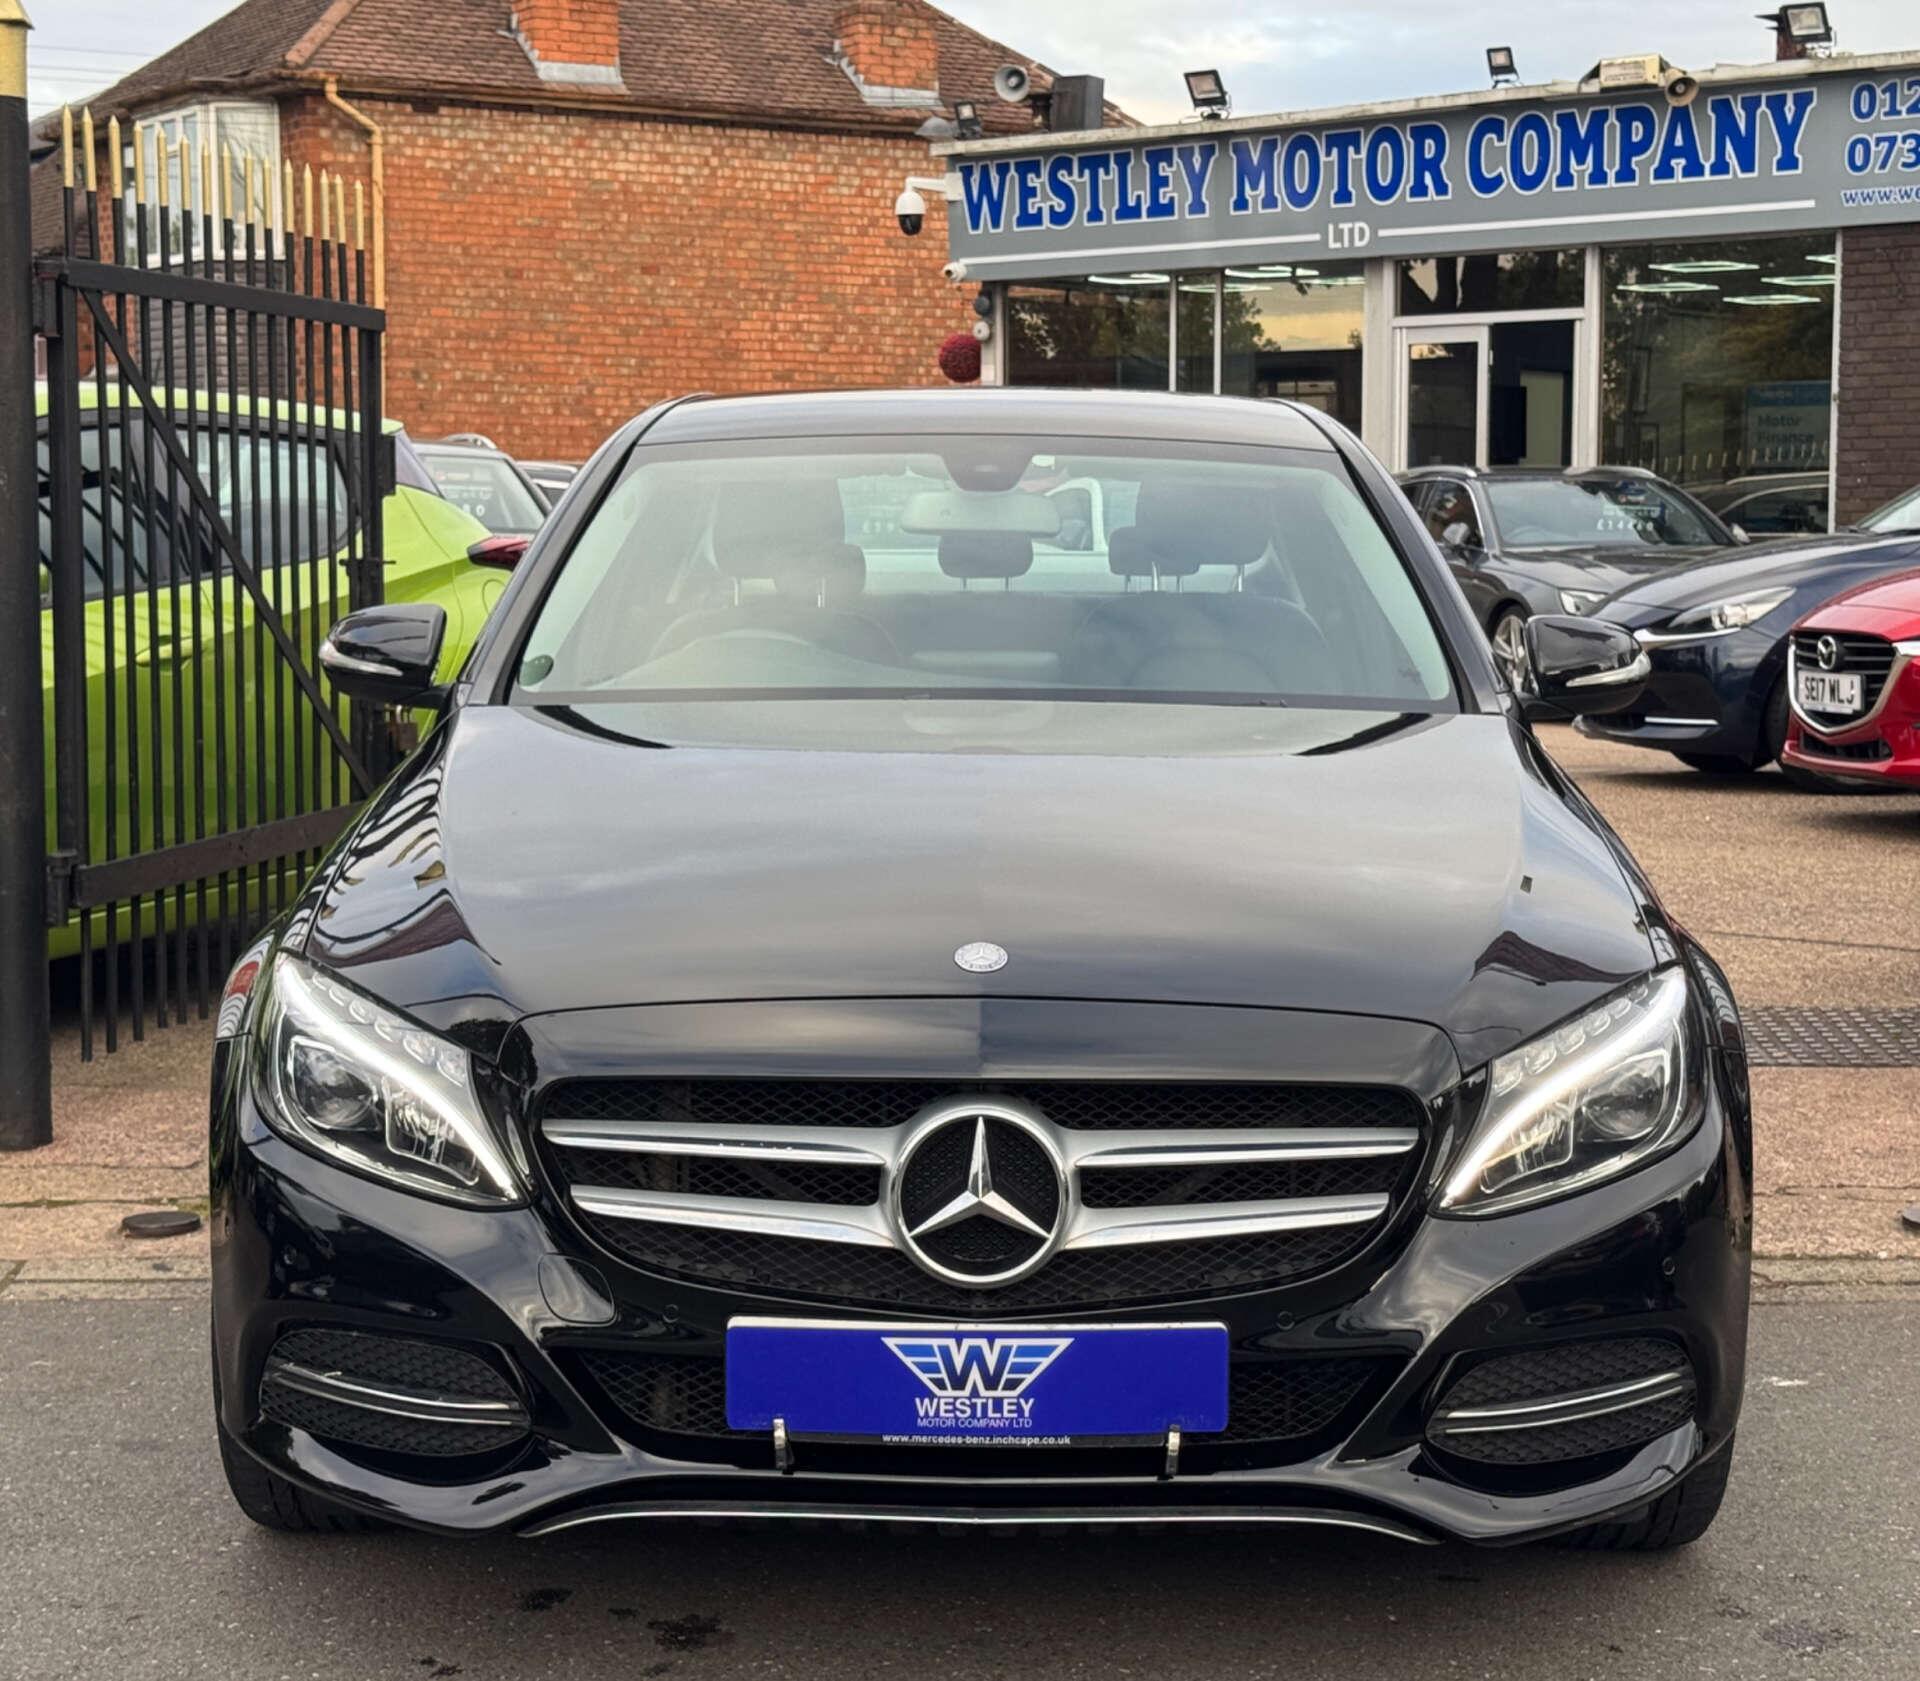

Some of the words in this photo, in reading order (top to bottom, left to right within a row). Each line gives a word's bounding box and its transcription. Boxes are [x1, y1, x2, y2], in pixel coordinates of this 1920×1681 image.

[1850, 76, 1920, 122] 012
[957, 142, 1217, 235] WESTLEY
[1229, 119, 1451, 216] MOTOR
[1466, 87, 1817, 199] COMPANY
[1844, 130, 1920, 175] 073
[1327, 221, 1370, 249] LTD
[915, 1397, 1035, 1418] WESTLEY
[917, 1418, 955, 1428] MOTOR
[958, 1418, 1010, 1428] COMPANY
[1013, 1419, 1033, 1428] LTD
[882, 1434, 1071, 1447] www.mercedes-benz.inchcape.co.uk
